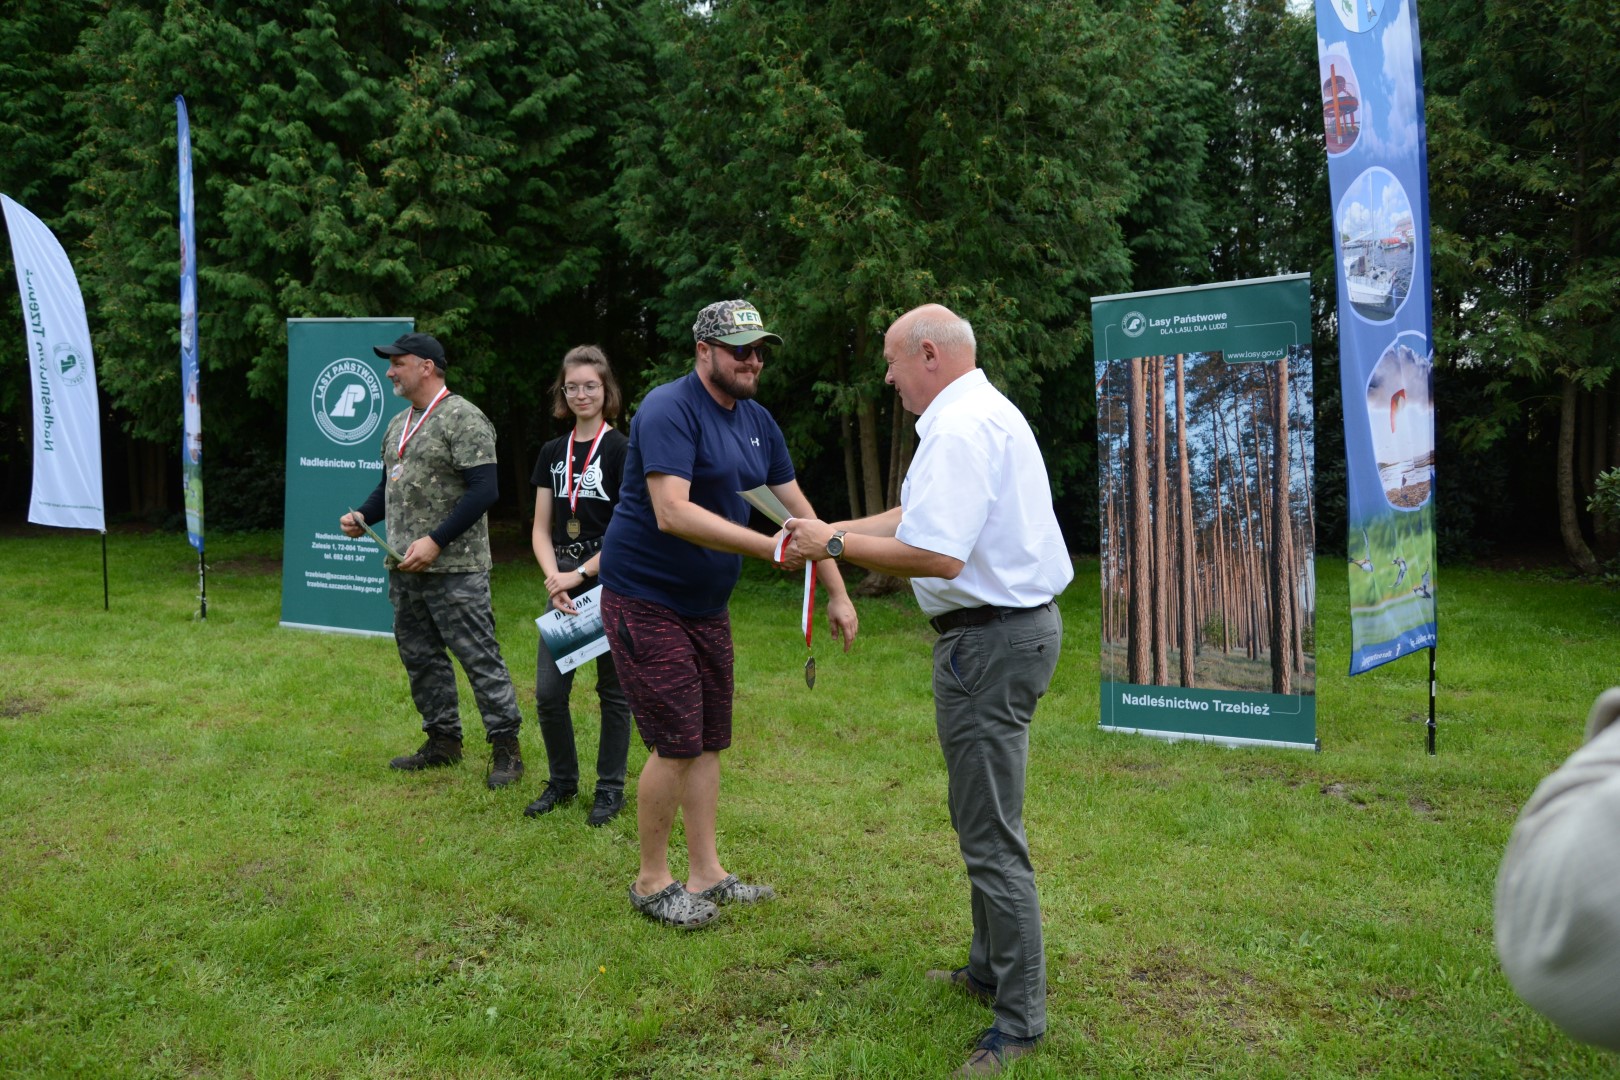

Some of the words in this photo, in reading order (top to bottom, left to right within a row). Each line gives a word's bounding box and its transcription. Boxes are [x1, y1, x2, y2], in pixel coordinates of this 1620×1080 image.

[1149, 317, 1171, 327] Lasy
[1173, 312, 1228, 325] Państwowe
[1160, 327, 1174, 335] DLA
[1194, 324, 1207, 332] DLA
[1209, 322, 1228, 331] LUDZI
[1227, 348, 1284, 360] www.lasy.gov.pl
[316, 372, 333, 399] LASY
[331, 361, 380, 400] PAŃSTWOWE
[300, 457, 356, 469] Nadleśnictwo
[358, 460, 384, 470] Trzebi
[357, 545, 379, 553] Tanowo
[1122, 693, 1209, 711] Nadleśnictwo
[1212, 699, 1270, 716] Trzebież
